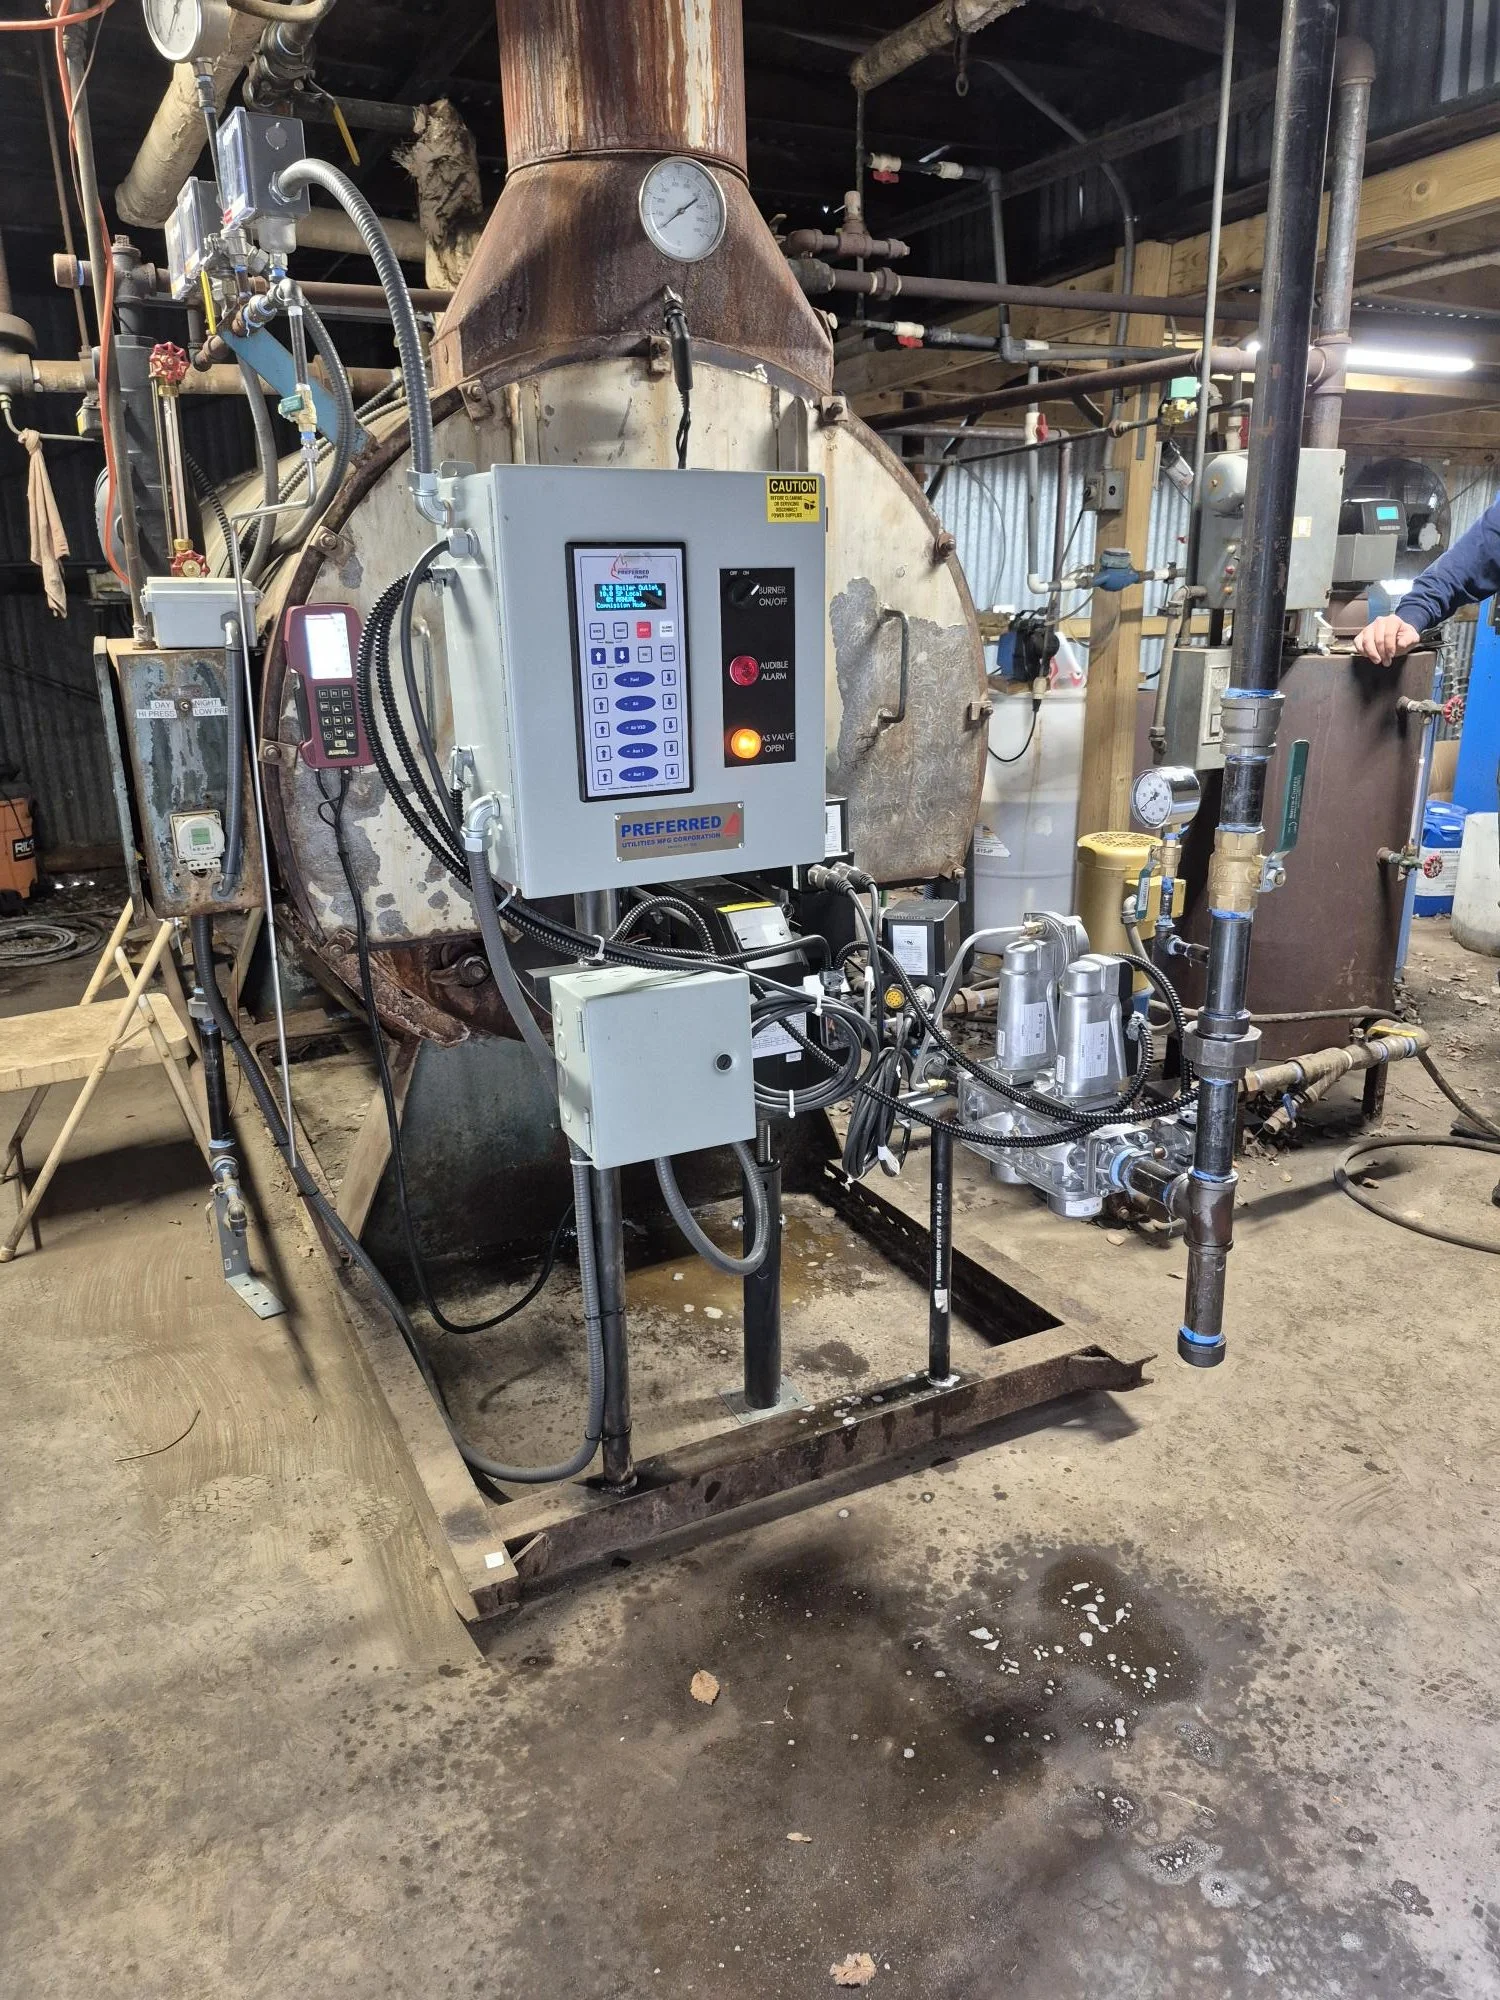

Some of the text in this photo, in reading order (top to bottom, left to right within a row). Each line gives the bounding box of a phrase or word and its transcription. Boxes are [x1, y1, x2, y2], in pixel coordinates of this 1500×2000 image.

[771, 480, 816, 492] CAUTION
[759, 586, 786, 594] BURNER
[759, 597, 788, 606] ON/OFF
[760, 660, 789, 669] AUDIBLE
[761, 672, 787, 681] ALARM
[154, 701, 171, 709] DAY
[194, 699, 217, 707] NIGHT
[194, 707, 212, 715] LOW
[762, 732, 795, 742] AS VALVE
[764, 744, 785, 753] OPEN
[621, 815, 722, 838] PREFERRED
[621, 838, 656, 848] UTILITIES
[657, 836, 674, 844] MFG
[673, 832, 721, 843] CORPORATION
